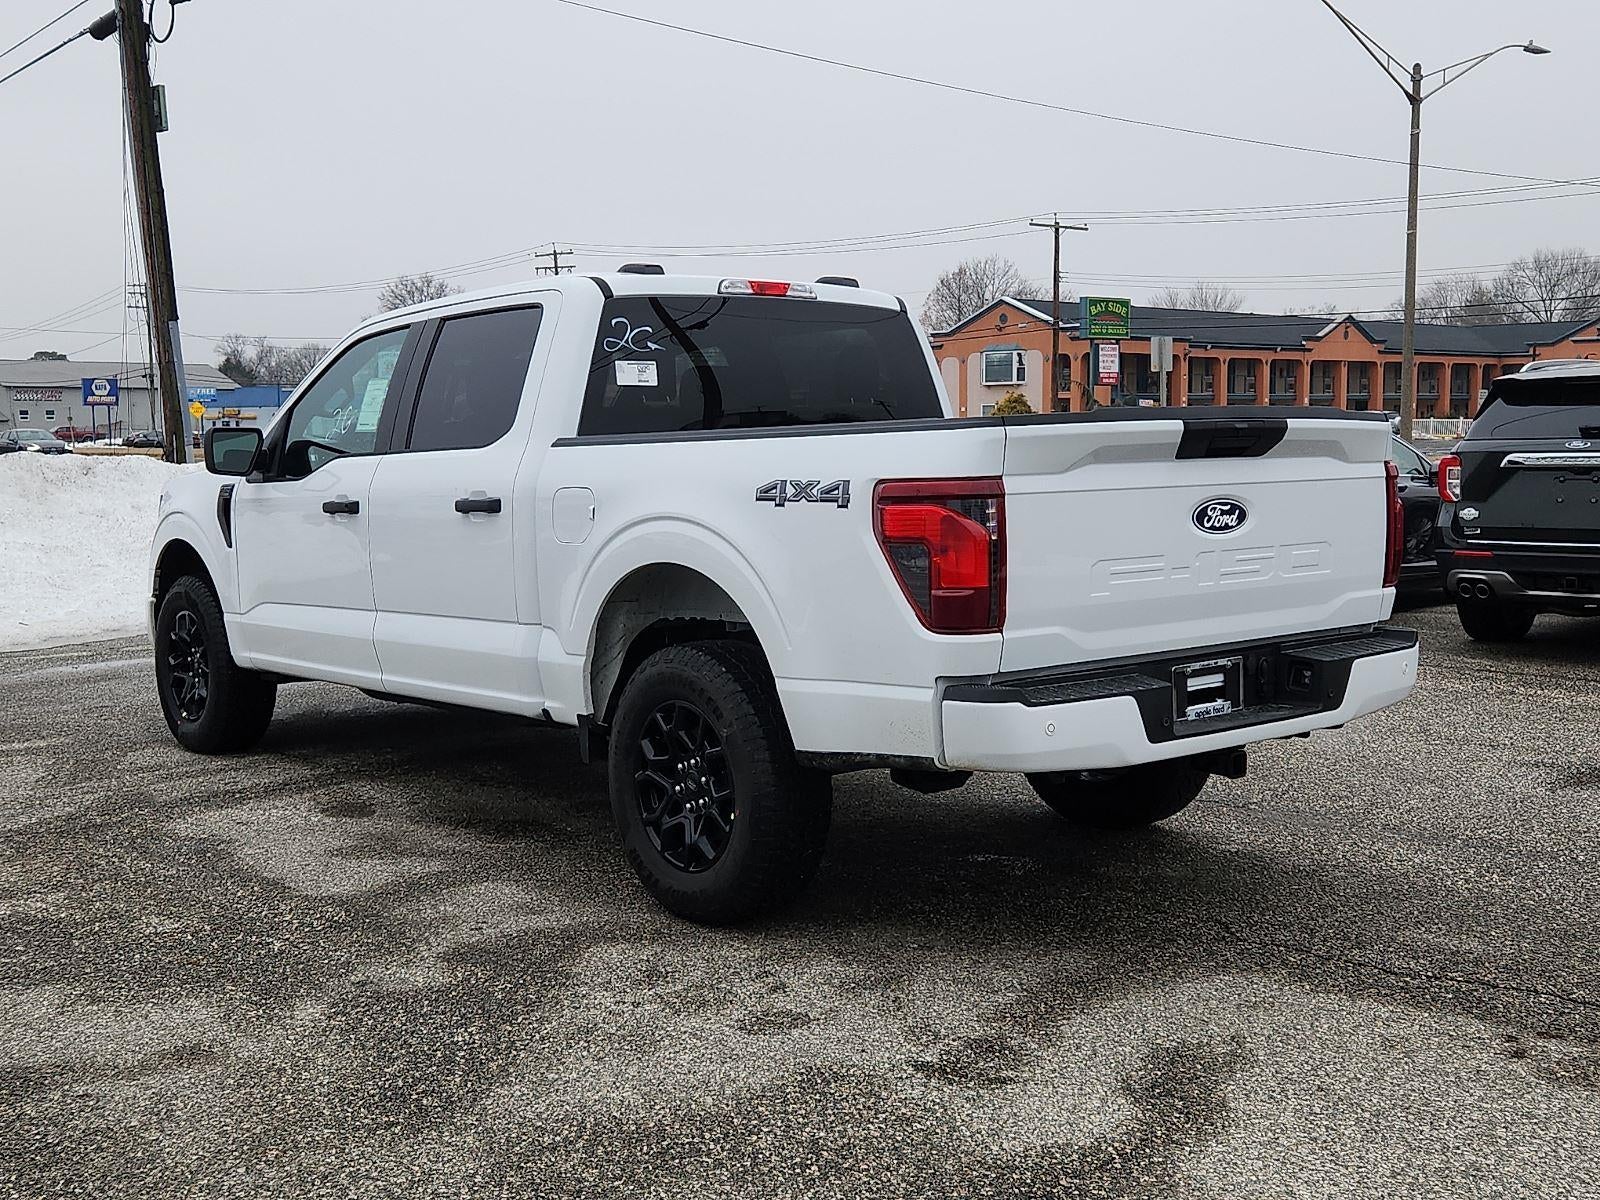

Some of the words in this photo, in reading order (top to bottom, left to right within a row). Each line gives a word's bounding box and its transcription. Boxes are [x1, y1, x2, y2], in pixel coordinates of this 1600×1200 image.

[1090, 302, 1106, 316] BAY
[1107, 302, 1127, 316] SIDE
[1203, 503, 1240, 528] Ford
[1090, 541, 1332, 597] F-150
[1194, 707, 1212, 719] apple
